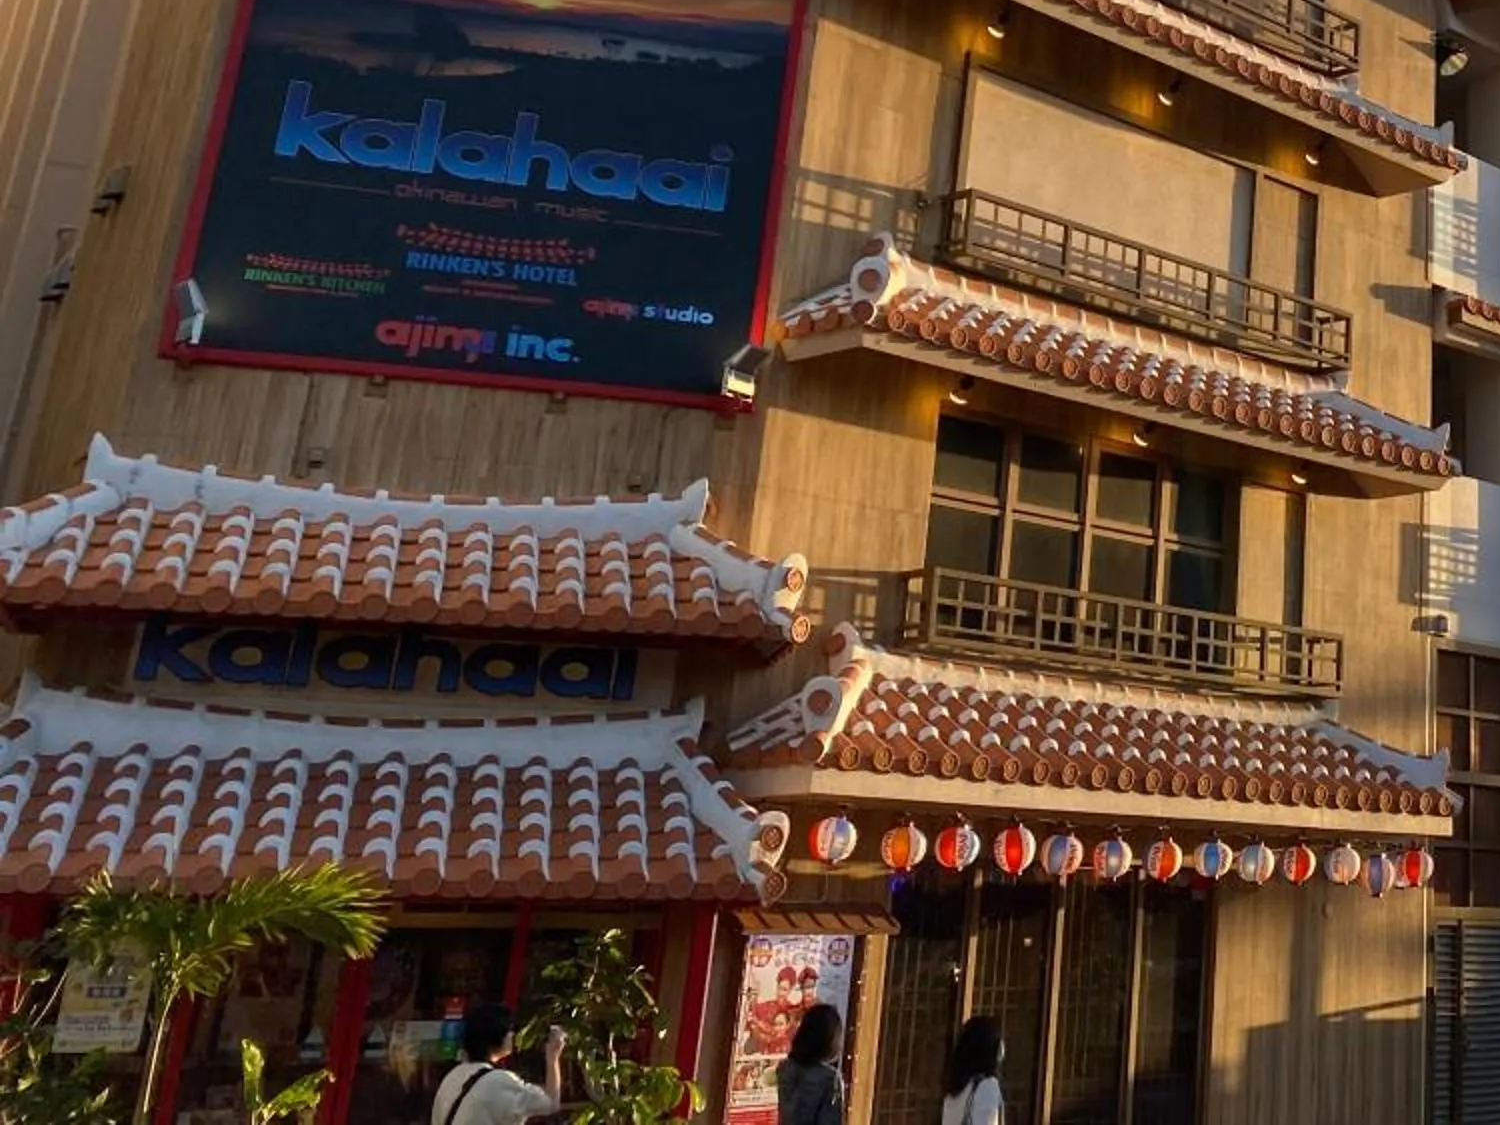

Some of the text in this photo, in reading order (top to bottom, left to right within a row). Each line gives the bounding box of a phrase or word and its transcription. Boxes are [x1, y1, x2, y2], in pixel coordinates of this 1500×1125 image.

[274, 79, 732, 213] kalahaai
[404, 250, 506, 278] RINKEN'S
[512, 262, 578, 287] HOTEL
[641, 301, 716, 326] studio
[505, 324, 582, 364] inc.
